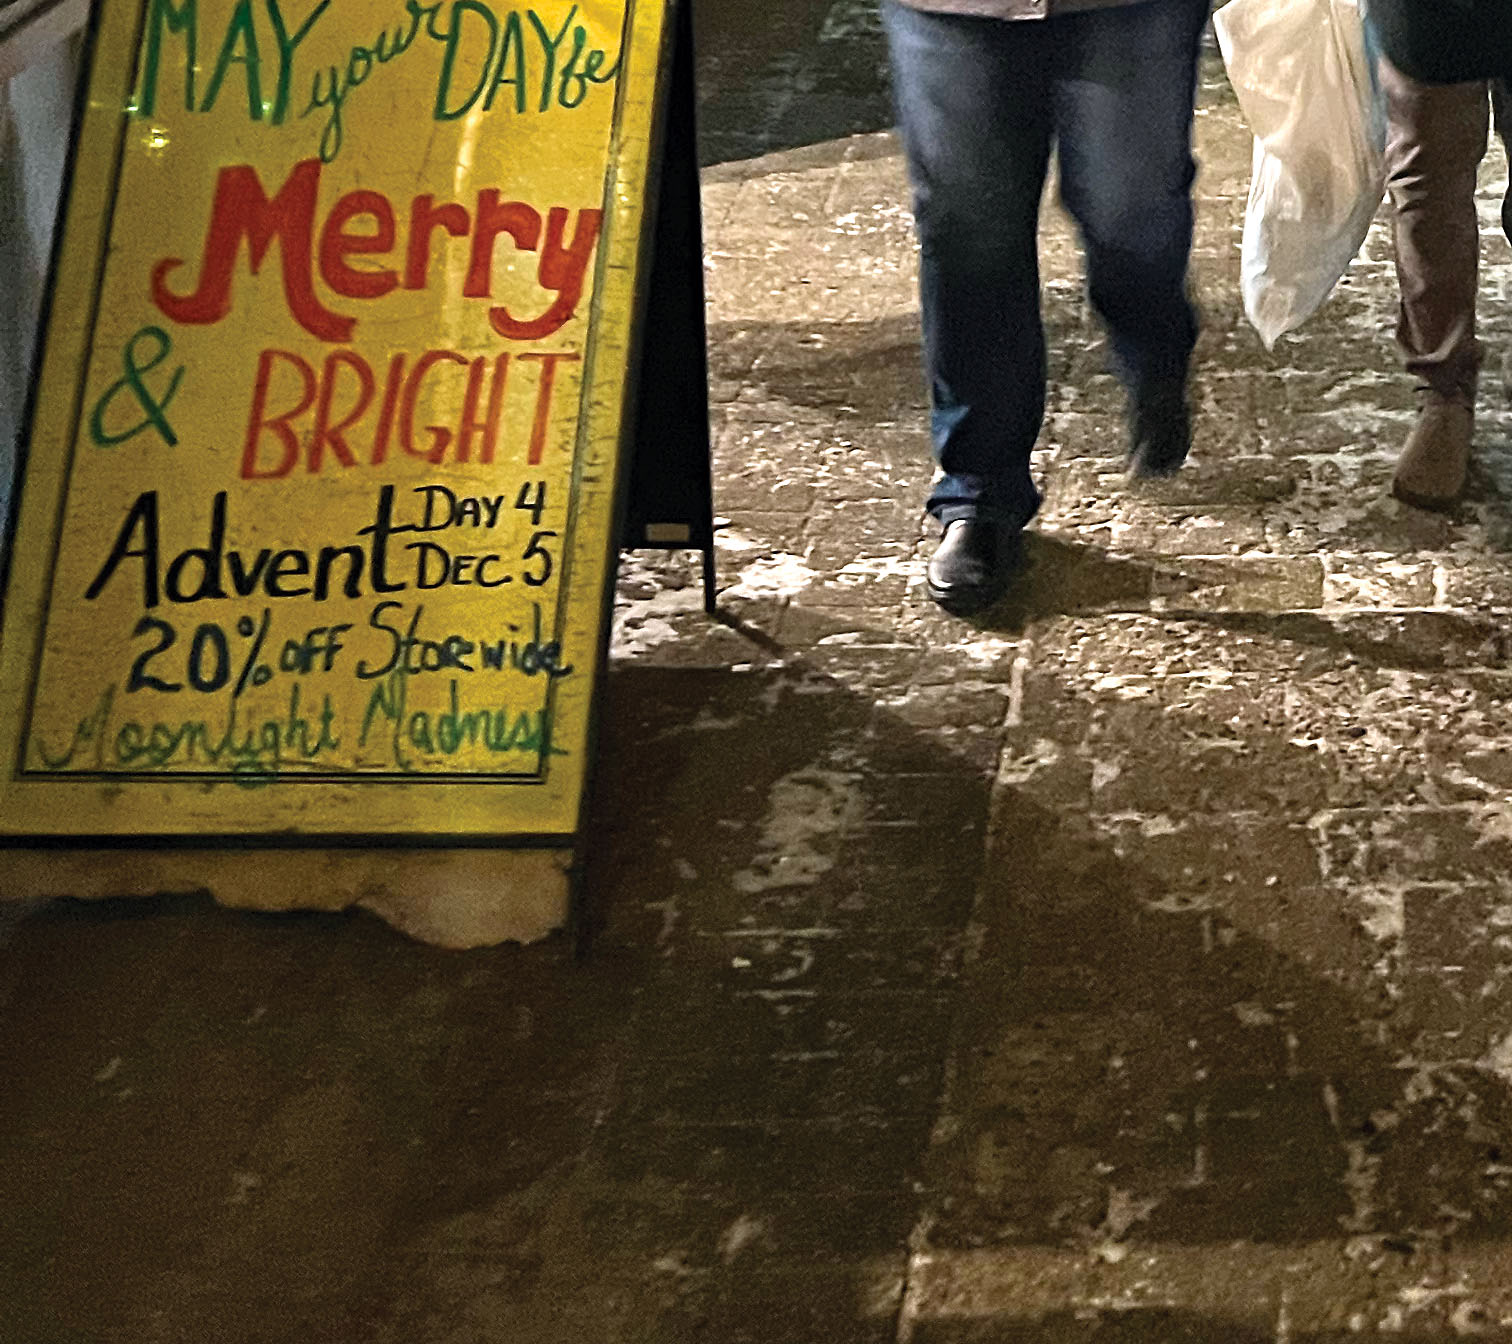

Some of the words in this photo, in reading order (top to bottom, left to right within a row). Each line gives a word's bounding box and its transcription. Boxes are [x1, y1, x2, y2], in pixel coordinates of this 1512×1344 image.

[434, 0, 578, 120] DAY
[559, 26, 621, 108] be
[150, 158, 601, 342] Merry
[89, 326, 185, 447] &
[240, 348, 580, 480] BRIGHT
[86, 484, 412, 608] Advent
[516, 481, 547, 525] 4
[524, 531, 557, 587] 5
[125, 609, 271, 699] 20%
[37, 680, 340, 786] Moonlight
